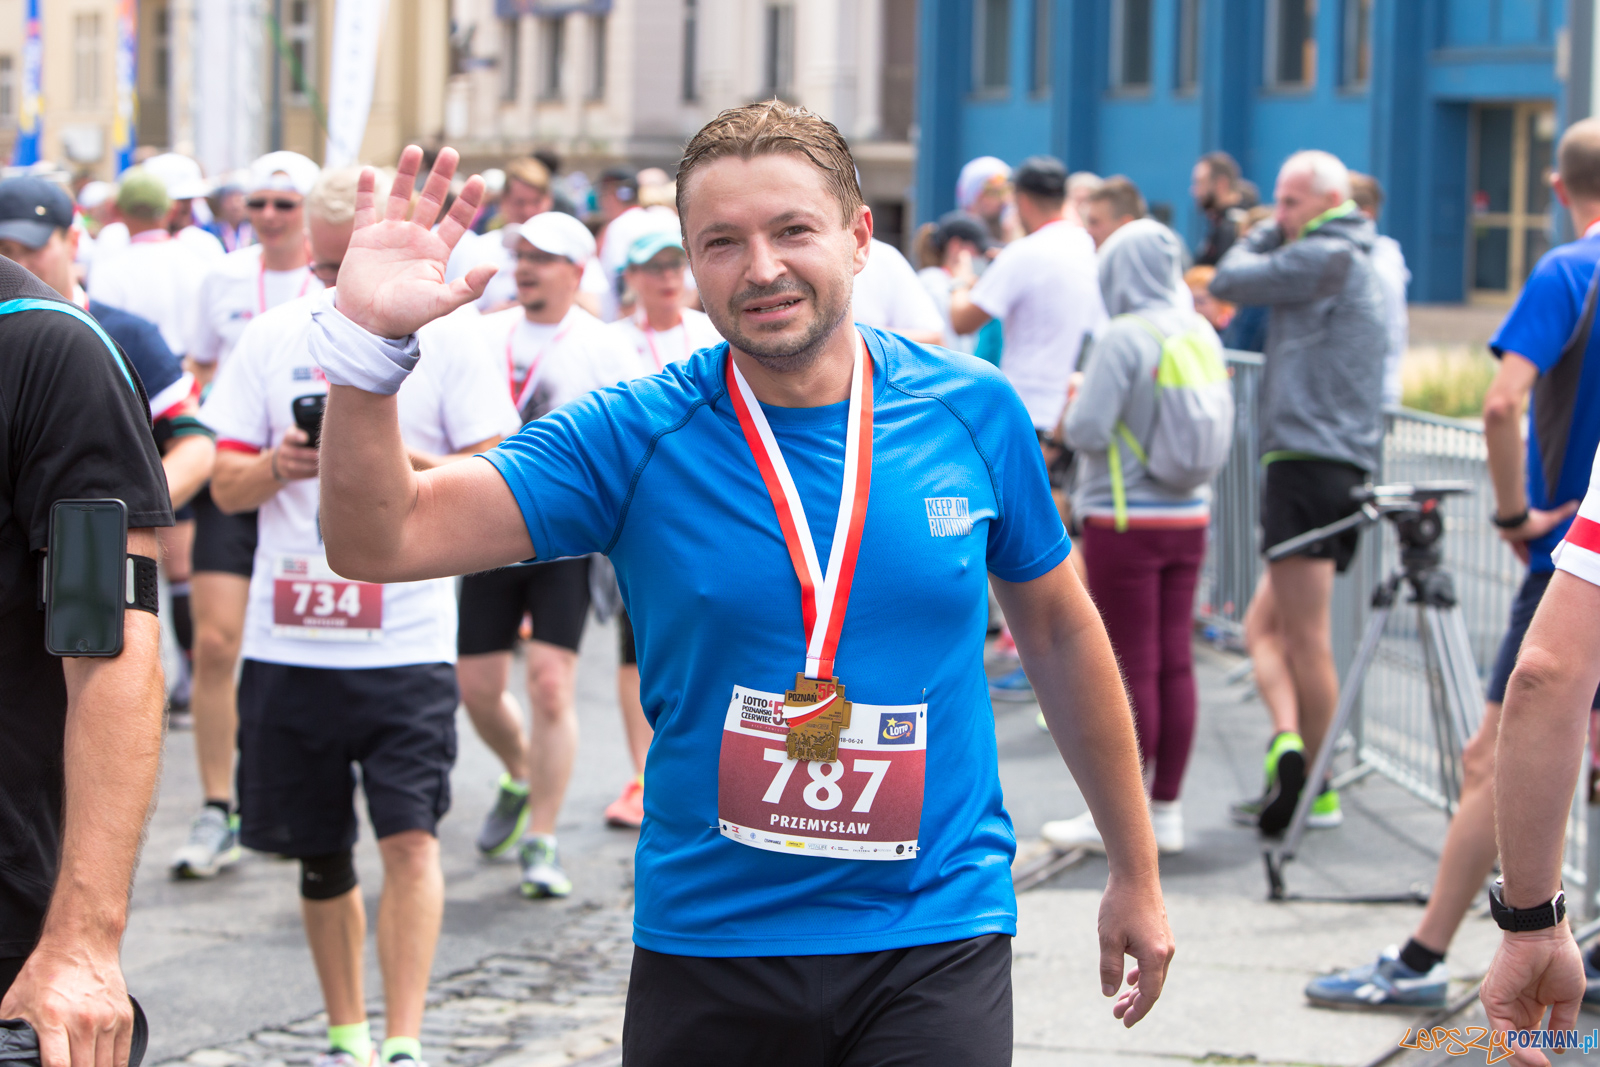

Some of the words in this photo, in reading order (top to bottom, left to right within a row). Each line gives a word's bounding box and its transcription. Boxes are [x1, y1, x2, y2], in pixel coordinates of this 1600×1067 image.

[927, 499, 952, 517] KEEP
[956, 499, 967, 517] ON
[291, 583, 361, 617] 734
[743, 694, 768, 708] LOTTO
[788, 692, 817, 703] POZNAŃ
[741, 711, 772, 724] CZERWIEC
[742, 705, 772, 716] POZNAŃSKI
[889, 724, 909, 736] LOTTO
[761, 747, 892, 813] 787
[769, 813, 871, 835] PRZEMYSŁAW
